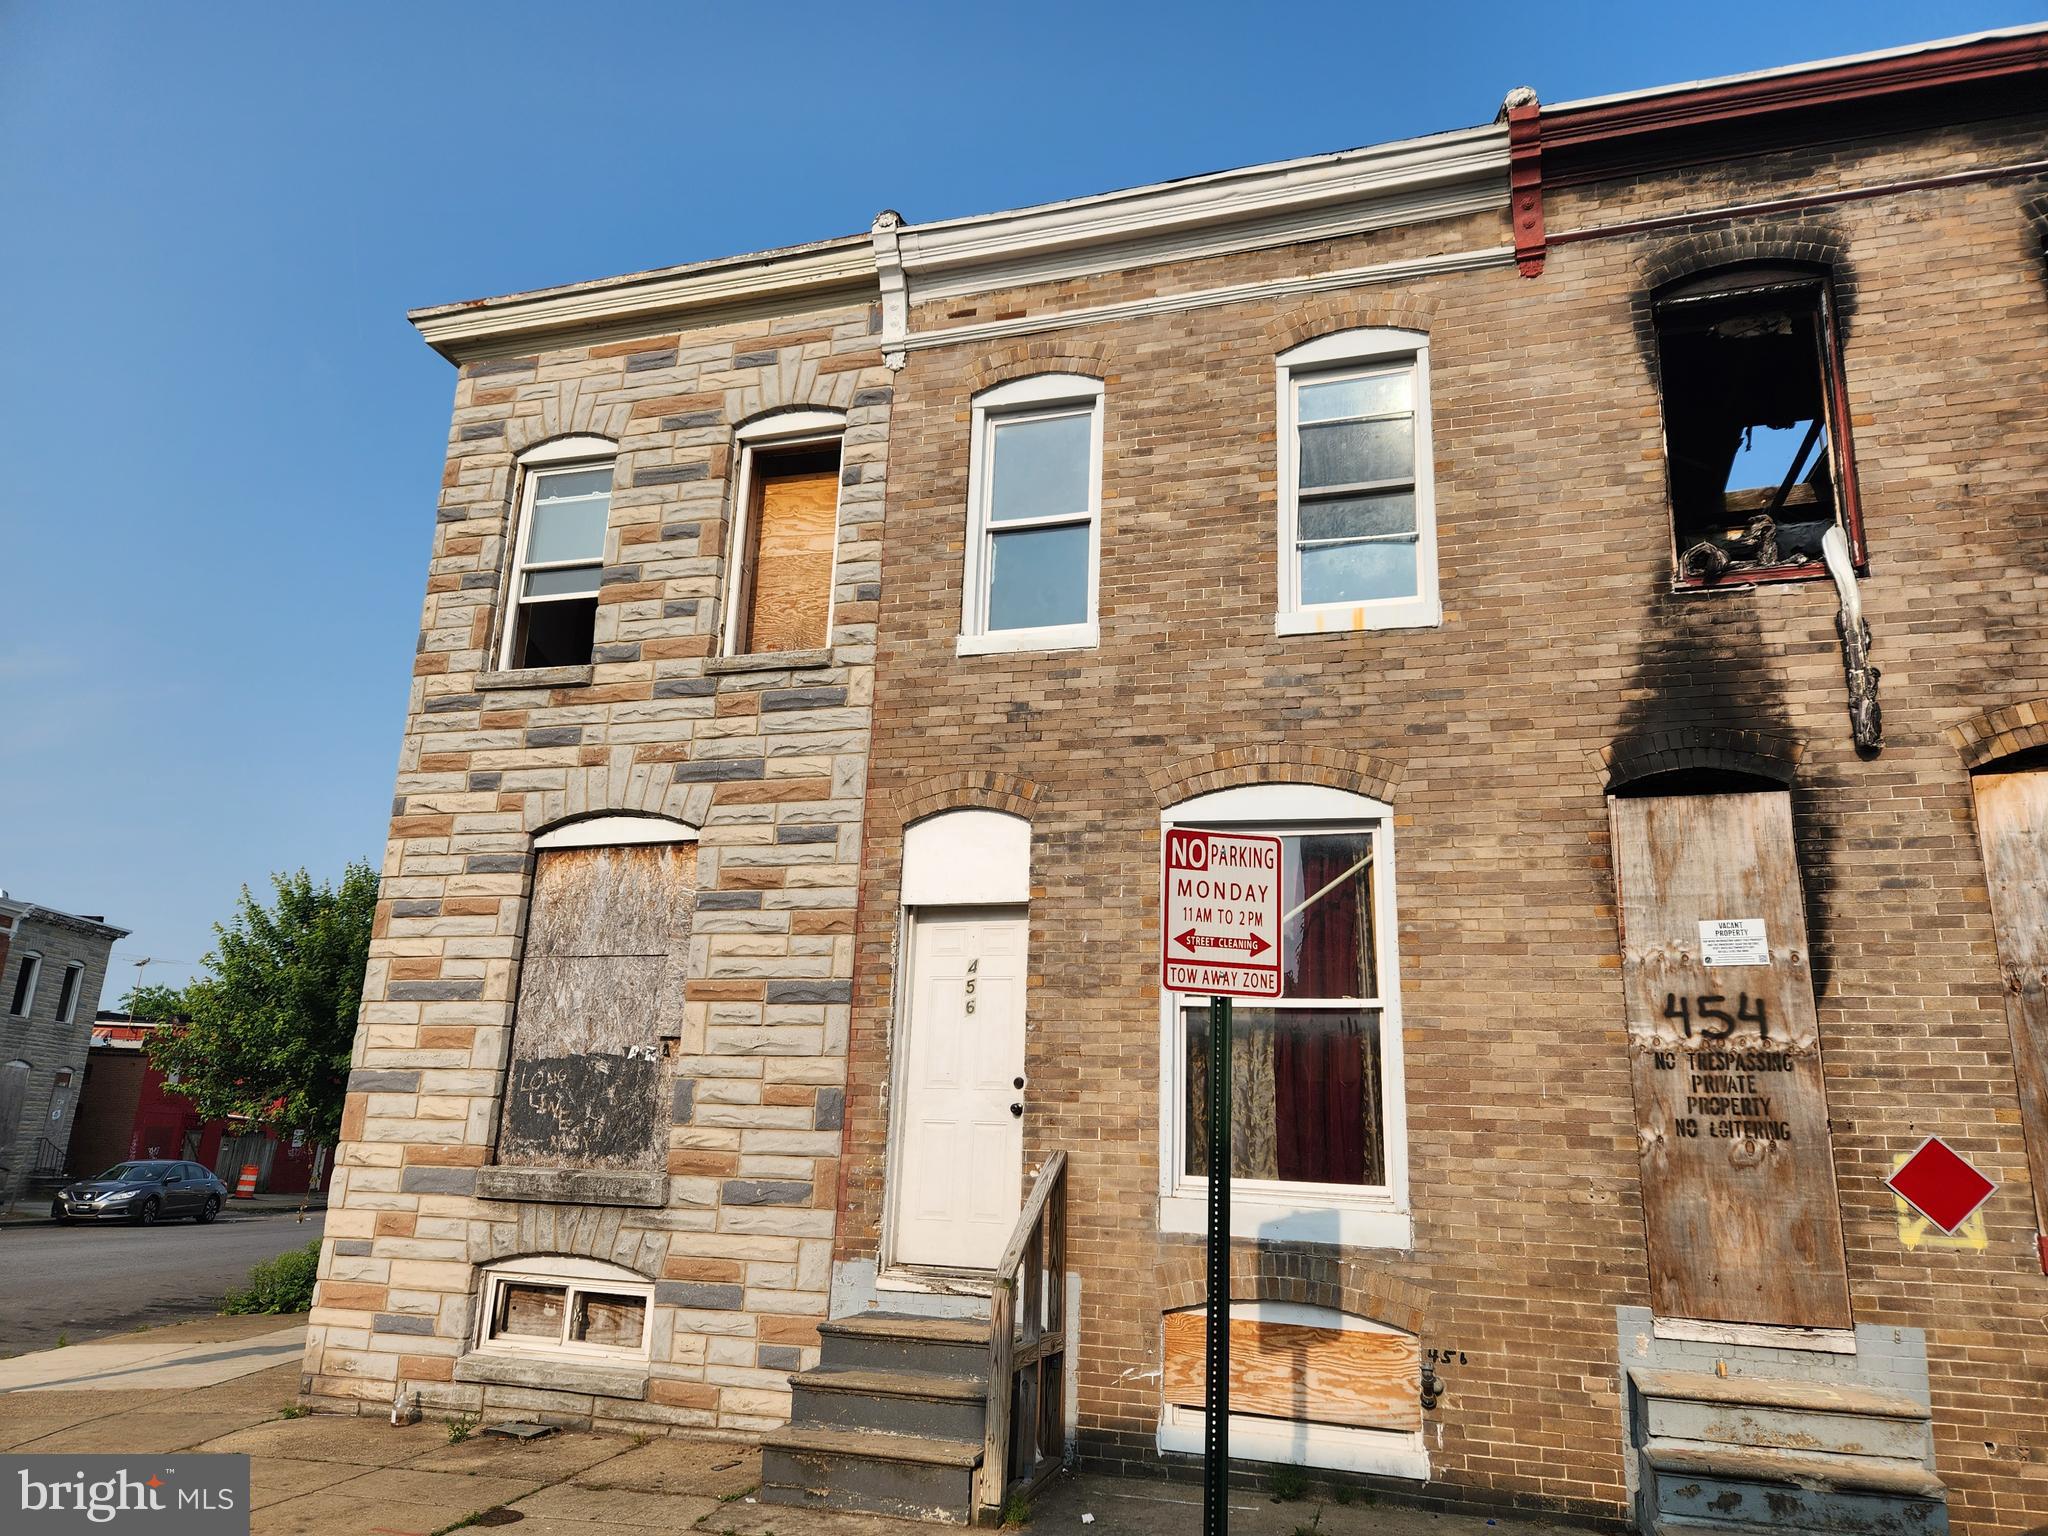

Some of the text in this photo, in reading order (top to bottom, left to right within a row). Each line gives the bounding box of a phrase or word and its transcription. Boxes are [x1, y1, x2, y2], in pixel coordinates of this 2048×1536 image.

[1171, 836, 1274, 870] NO PARKING
[1177, 878, 1268, 903] MONDAY
[1218, 909, 1233, 925] TO
[1718, 921, 1743, 929] VACANT
[1186, 936, 1259, 950] STREET CLEANING
[1715, 929, 1749, 937] PROPERTY
[1170, 967, 1275, 989] TOW AWAY ZONE
[1664, 991, 1769, 1040] 454
[1654, 1052, 1794, 1072] NO TRESPASSING
[1691, 1074, 1758, 1094] PRIVATE
[1687, 1097, 1772, 1116] PROPERTY
[1675, 1118, 1791, 1141] NO LOITERING
[1427, 1348, 1468, 1365] 456
